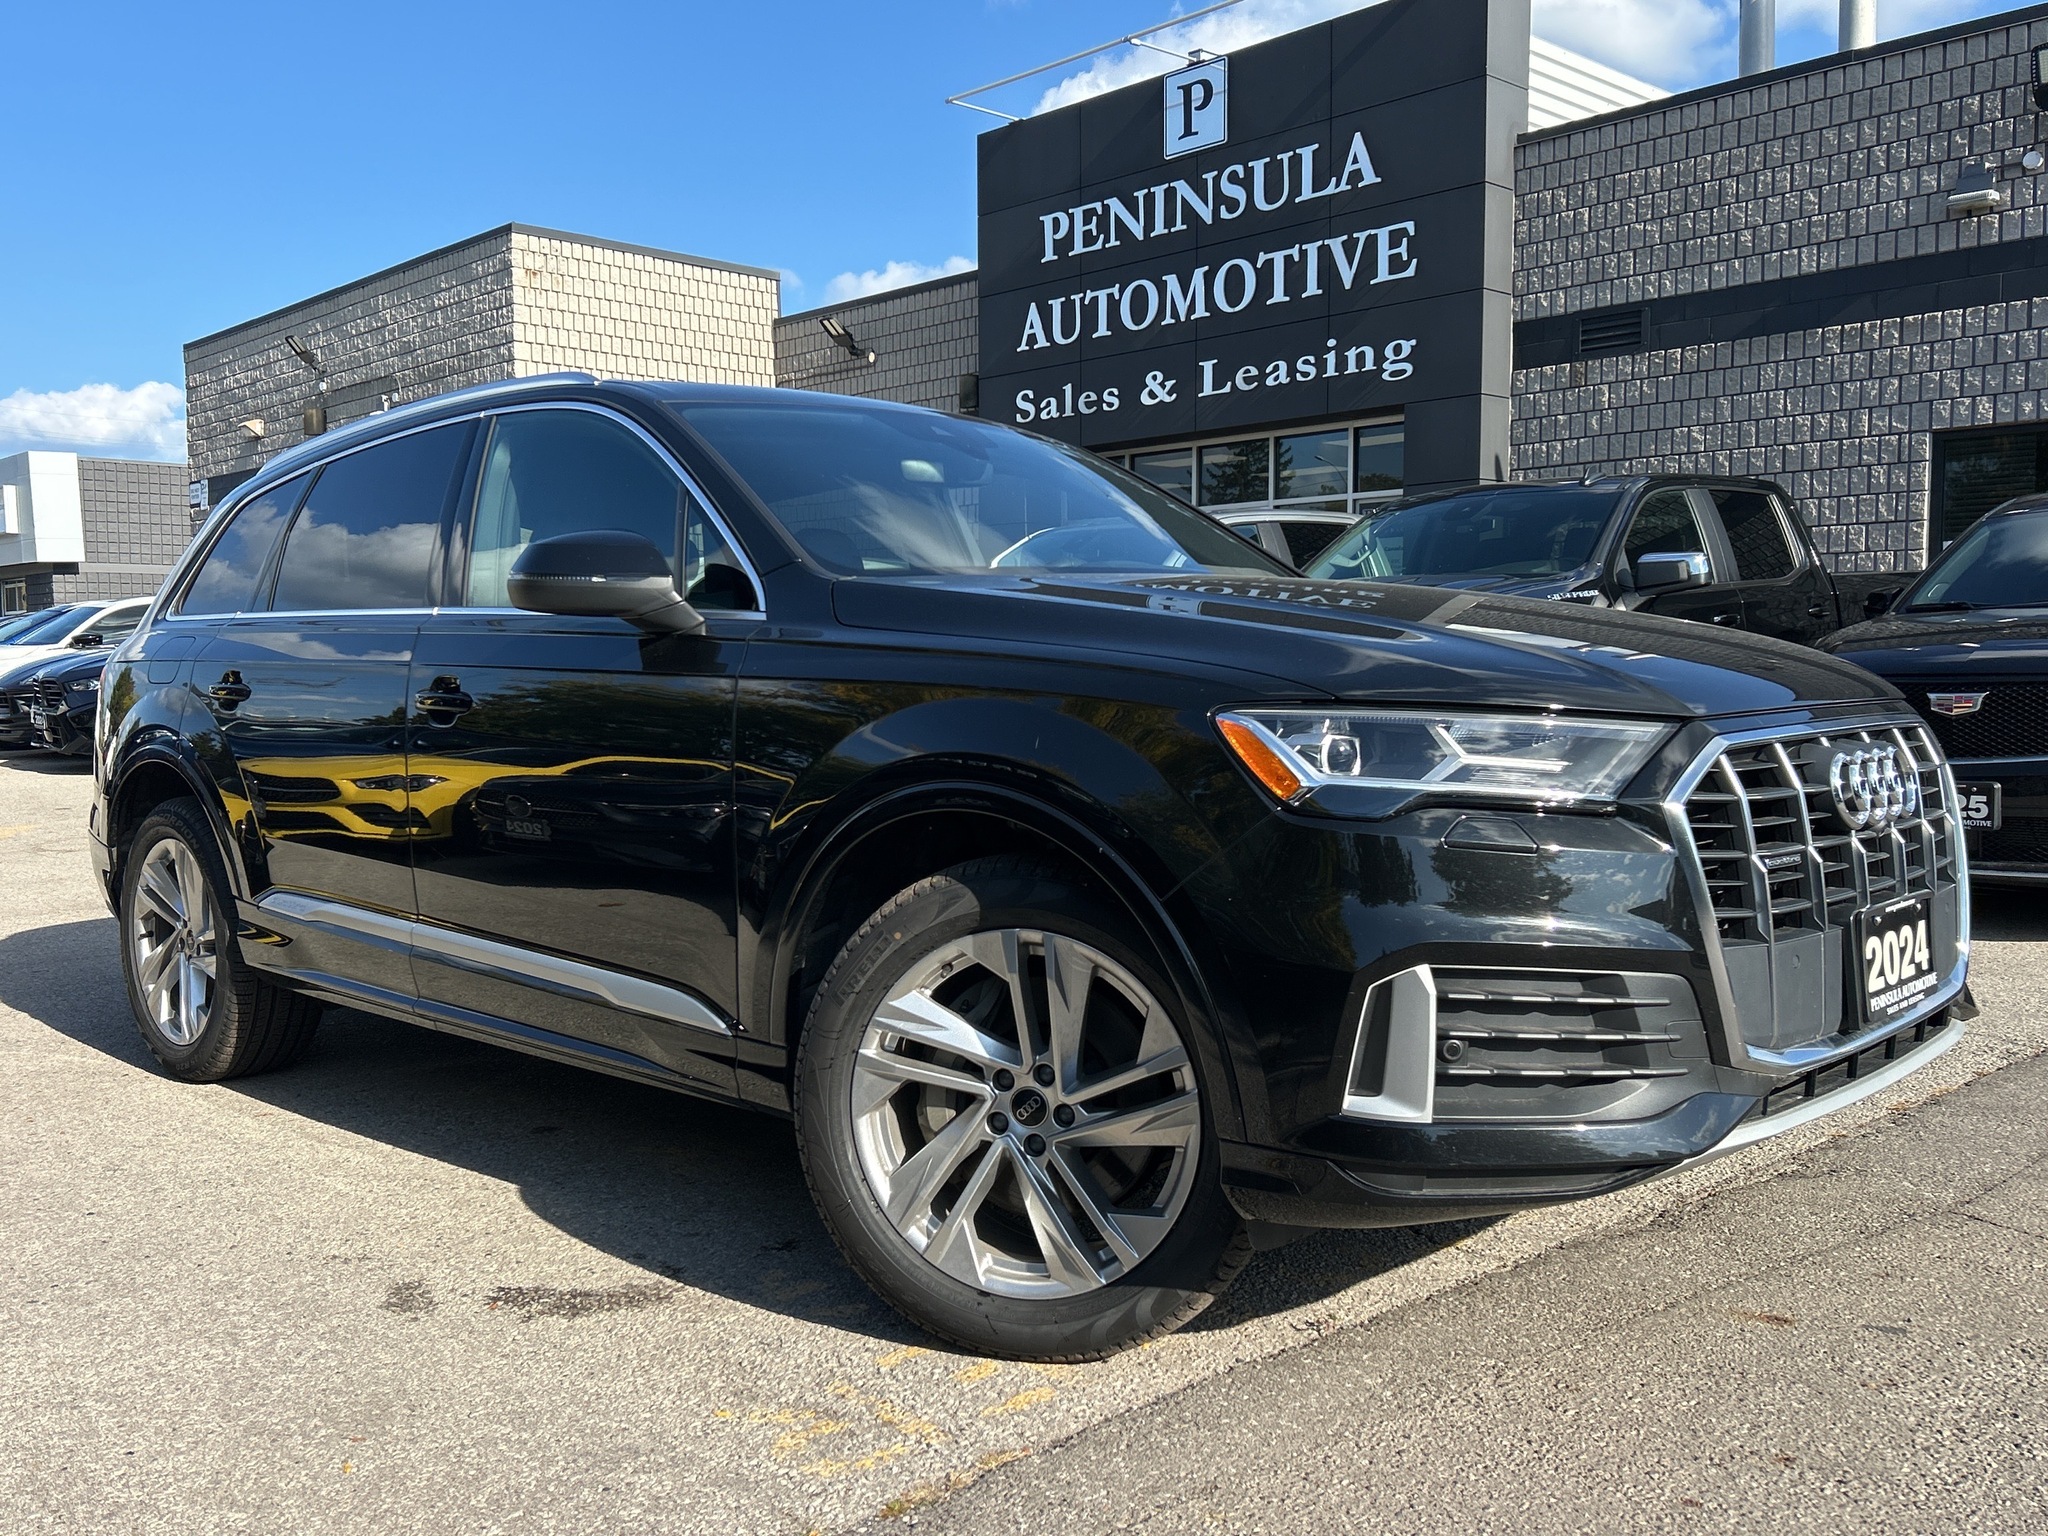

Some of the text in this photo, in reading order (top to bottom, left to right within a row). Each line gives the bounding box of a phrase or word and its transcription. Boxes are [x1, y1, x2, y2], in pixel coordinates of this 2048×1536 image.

[1176, 77, 1214, 141] P
[1038, 131, 1382, 263] PENINSULA
[1015, 220, 1418, 352] AUTOMOTIVE
[1014, 338, 1418, 424] Sales & Leasing
[1865, 919, 1930, 993] 2024
[1870, 971, 1938, 1012] PENINSULA AUTOMOTIVE
